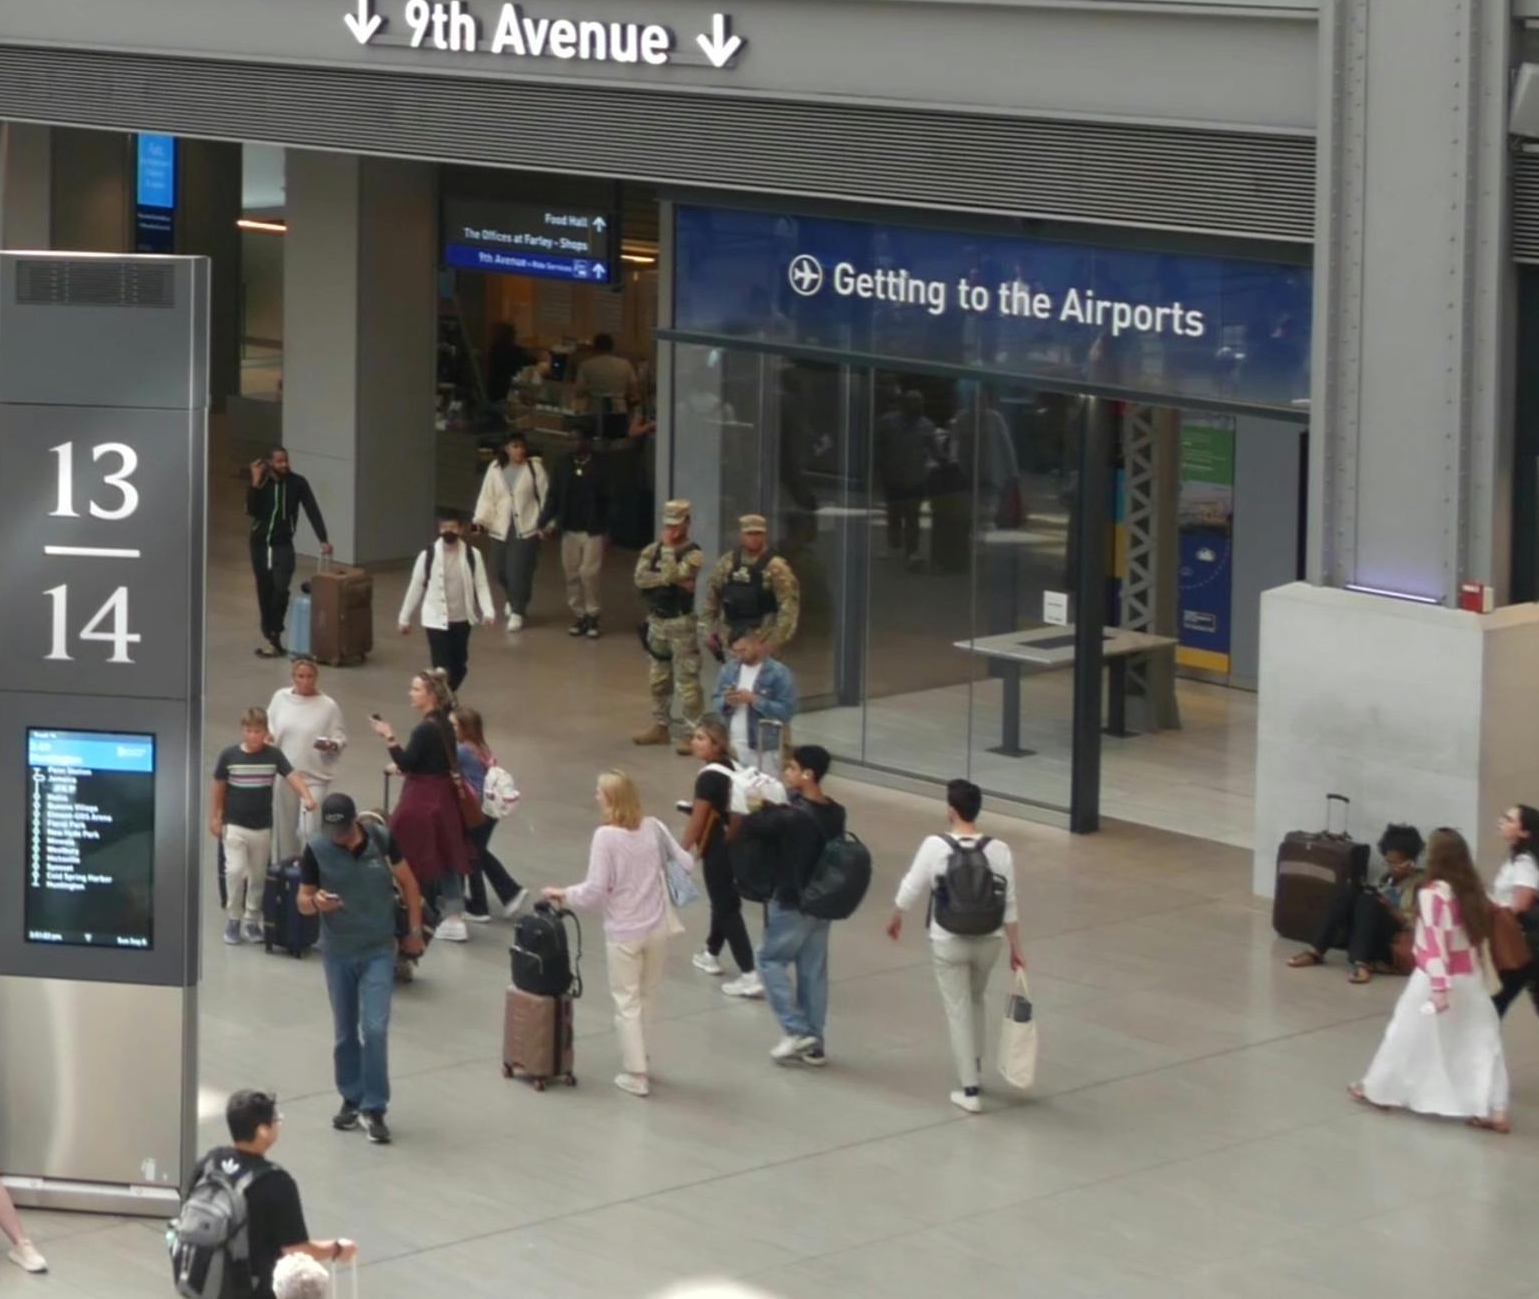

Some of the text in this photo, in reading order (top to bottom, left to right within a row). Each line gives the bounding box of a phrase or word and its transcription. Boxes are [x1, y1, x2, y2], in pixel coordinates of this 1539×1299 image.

[491, 3, 668, 64] Avenue
[463, 228, 480, 239] The
[482, 230, 511, 243] Offices
[514, 234, 522, 243] at
[525, 234, 553, 248] Farley
[560, 238, 588, 251] Shops
[545, 213, 588, 227] Food Hall
[479, 252, 493, 263] 9th
[496, 255, 526, 267] Avenue
[835, 263, 1203, 336] Getting to the Airports
[51, 443, 138, 519] 13
[45, 585, 140, 662] 14
